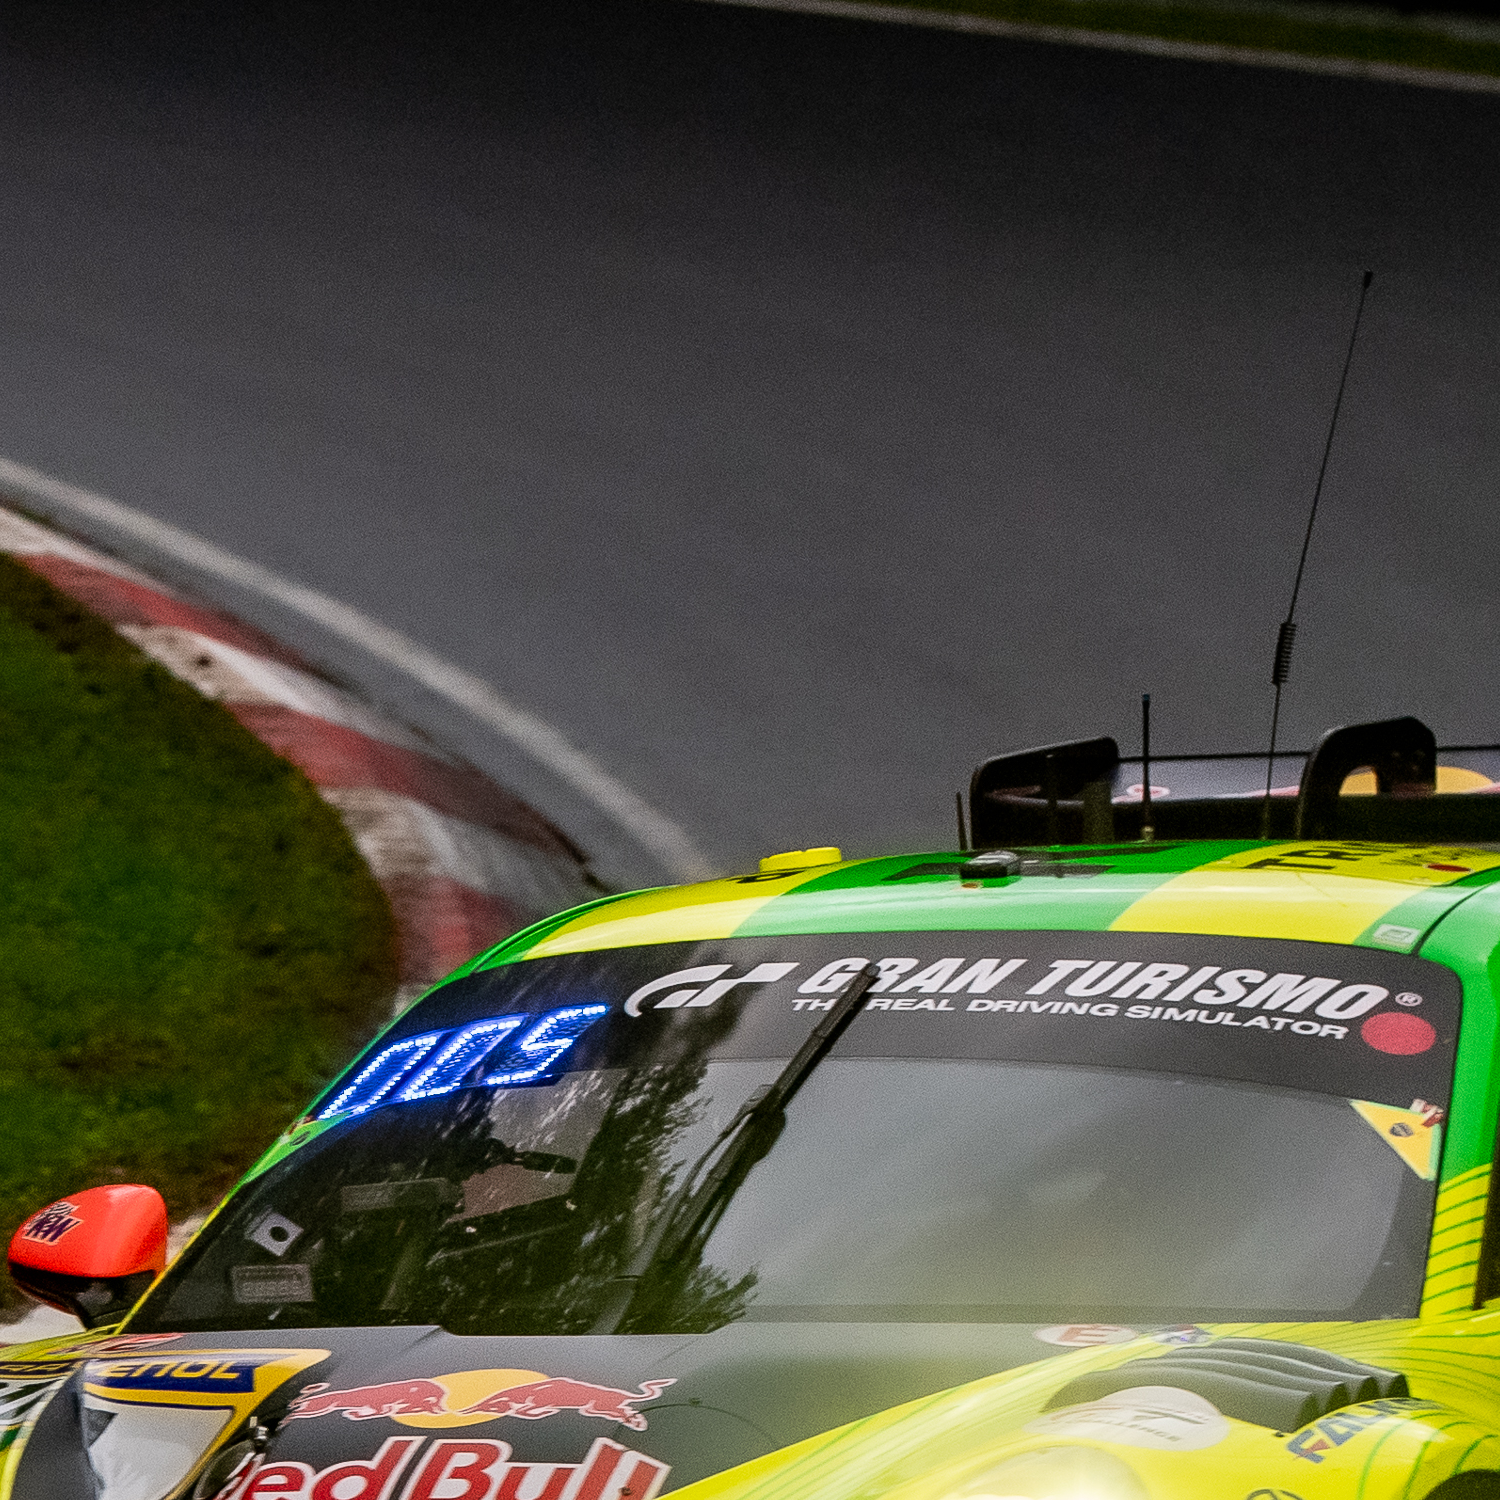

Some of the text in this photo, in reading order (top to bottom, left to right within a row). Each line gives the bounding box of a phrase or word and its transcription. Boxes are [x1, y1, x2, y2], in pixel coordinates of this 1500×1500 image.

[797, 957, 1028, 995] GRAN
[1025, 958, 1390, 1021] TURISMO
[792, 998, 1349, 1041] TH REAL DRIVING SIMULATOR
